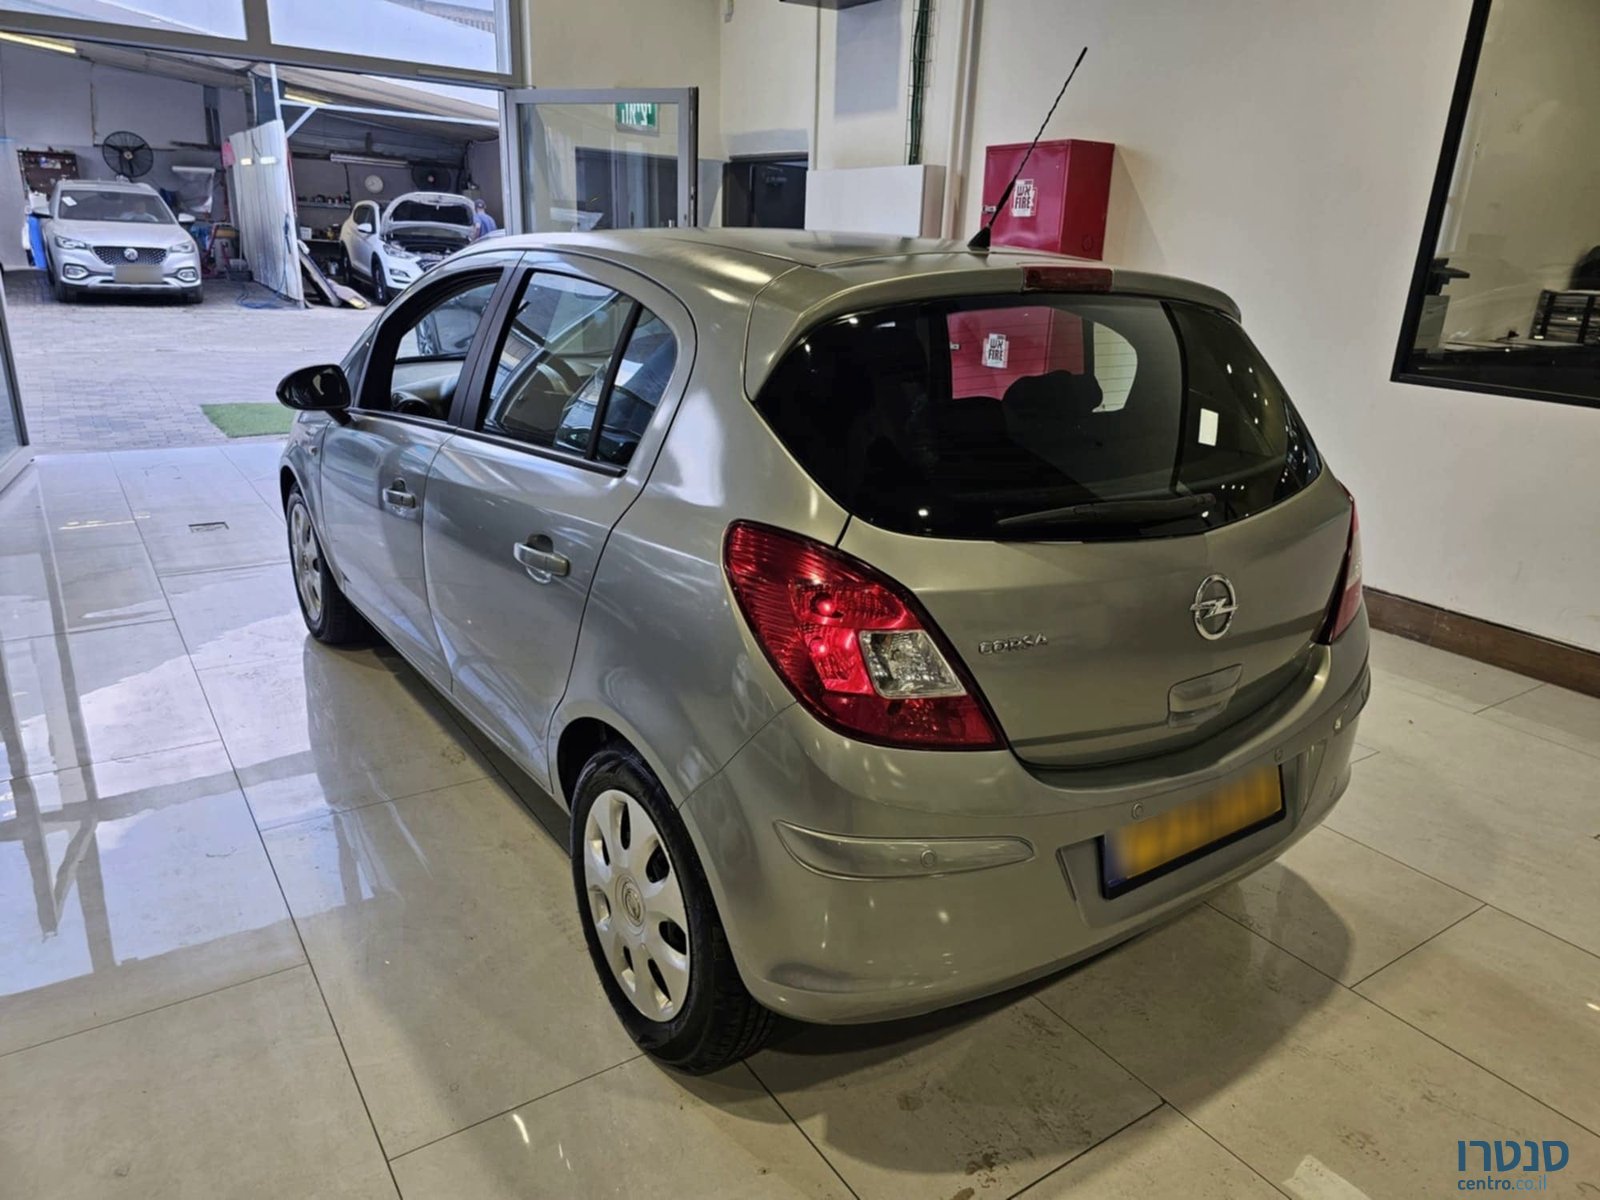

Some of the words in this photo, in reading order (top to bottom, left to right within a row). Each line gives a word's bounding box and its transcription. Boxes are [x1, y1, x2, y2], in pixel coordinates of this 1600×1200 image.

[1014, 196, 1031, 209] FIRE
[988, 348, 1004, 361] FIRE
[978, 632, 1048, 655] CORSA
